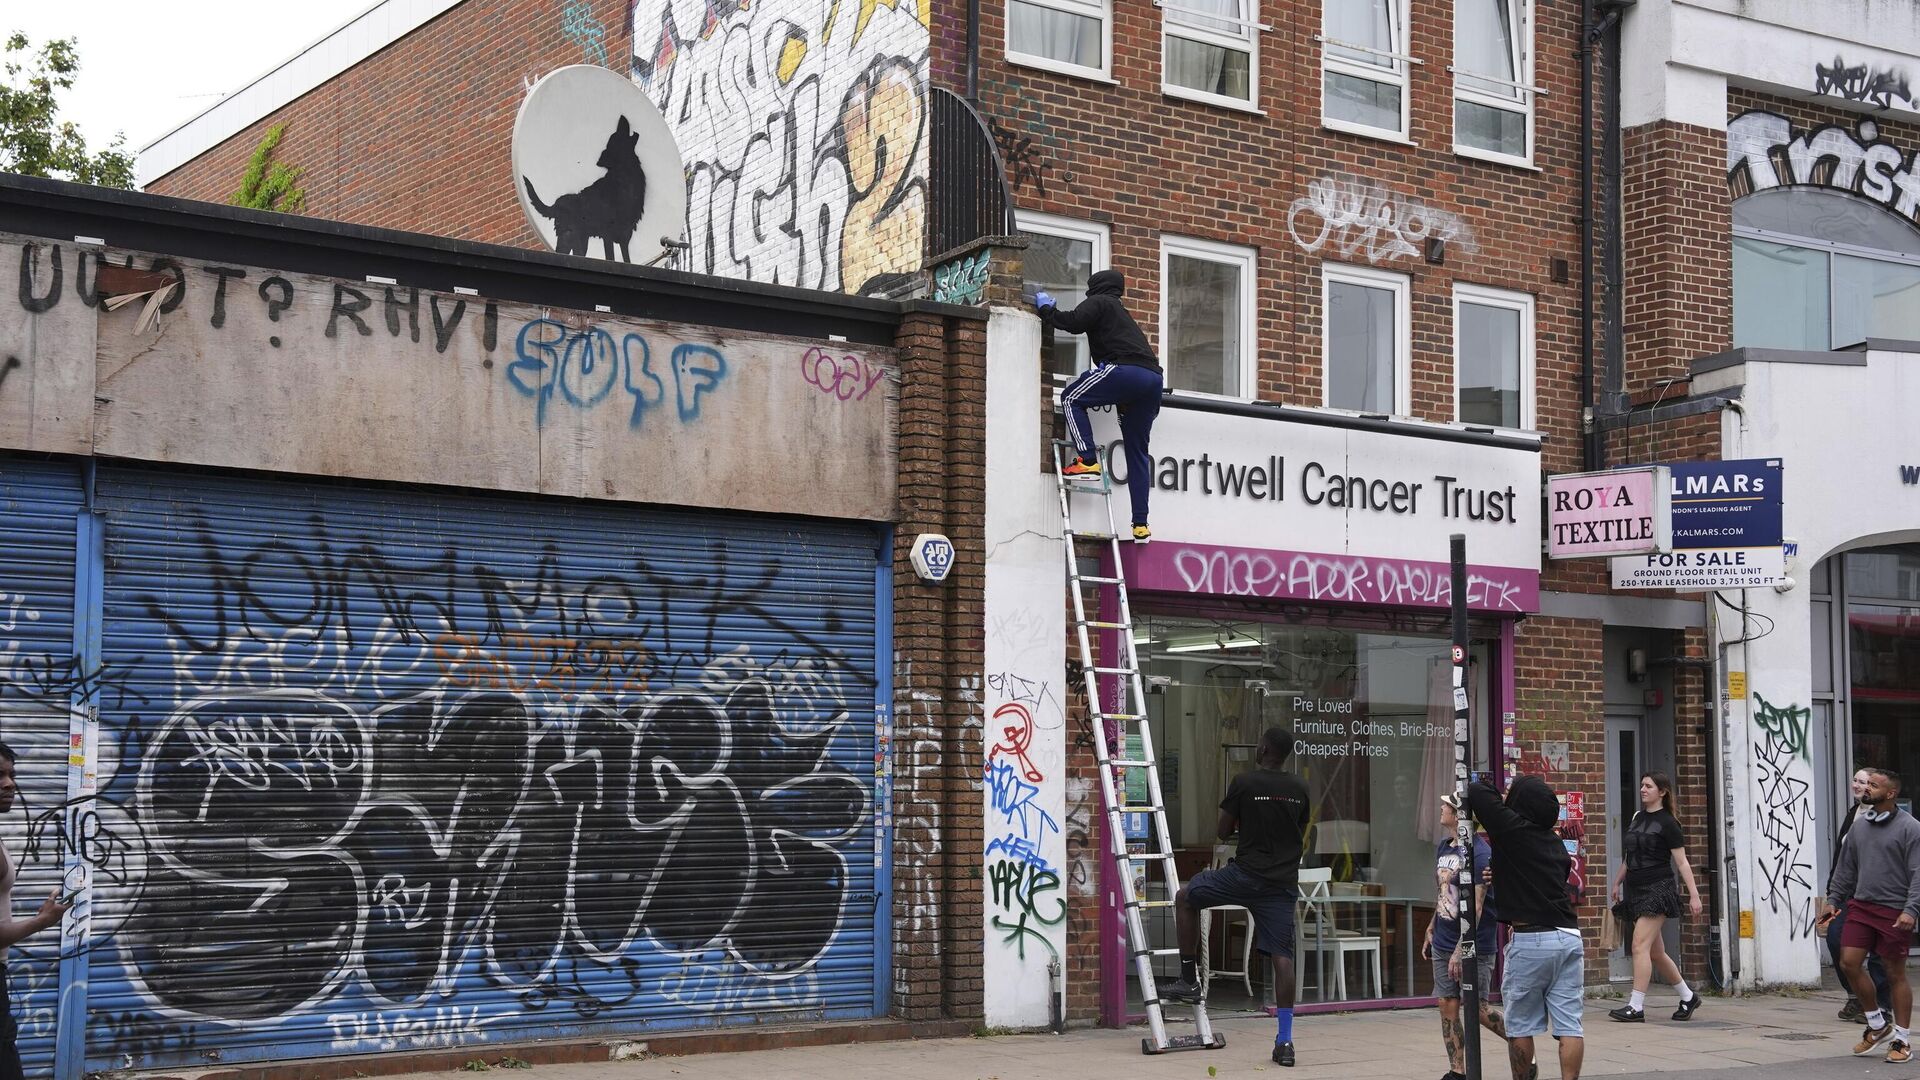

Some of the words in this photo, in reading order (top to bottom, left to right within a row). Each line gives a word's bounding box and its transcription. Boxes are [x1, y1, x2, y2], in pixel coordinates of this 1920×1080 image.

[1302, 462, 1422, 514] Cancer
[1435, 475, 1516, 523] Trust
[1671, 474, 1764, 495] LMARs
[1554, 485, 1634, 512] ROYA
[1671, 506, 1698, 514] NDON'S
[1553, 516, 1654, 546] TEXTILE
[1671, 527, 1744, 537] .KALMARS.COM
[1648, 553, 1687, 568] FOR
[1696, 551, 1746, 567] SALE
[1634, 569, 1672, 577] GROUND
[1675, 568, 1704, 576] FLOOR
[1707, 568, 1738, 576] RETAIL
[1740, 567, 1762, 575] UNIT
[1620, 579, 1663, 587] 250-YEAR
[1665, 578, 1717, 586] LEASEHOLD
[1720, 578, 1745, 586] 3,751
[1748, 577, 1761, 585] SQ
[1293, 697, 1314, 713] Pre
[1318, 698, 1352, 714] Loved
[1293, 719, 1347, 737] Furniture,
[1351, 720, 1396, 738] Clothes,
[1293, 740, 1349, 758] Cheapest
[1353, 741, 1389, 757] Prices
